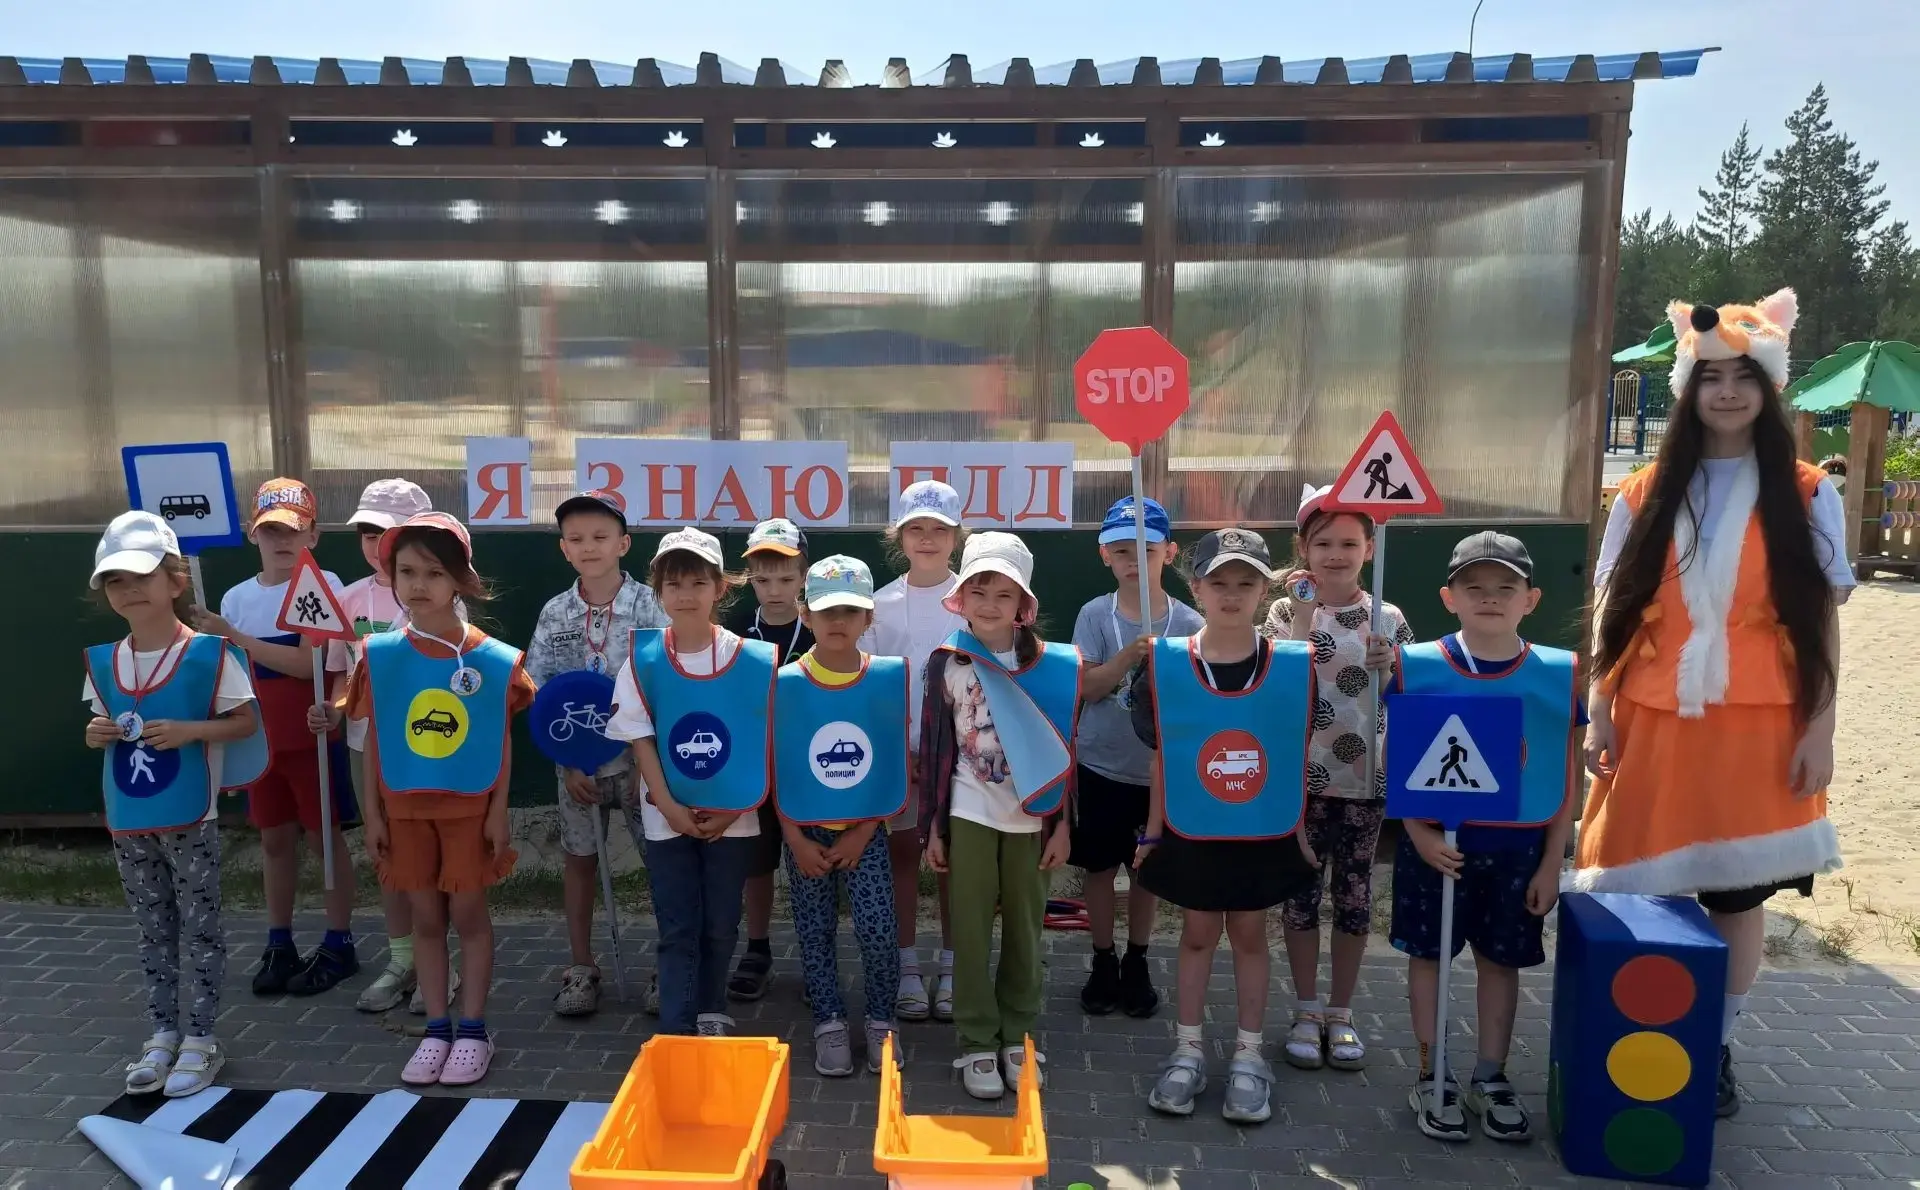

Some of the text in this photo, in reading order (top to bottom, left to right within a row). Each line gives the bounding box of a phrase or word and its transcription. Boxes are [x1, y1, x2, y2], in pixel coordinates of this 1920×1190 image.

[1086, 366, 1175, 404] STOP
[471, 462, 528, 520] Я
[588, 462, 844, 521] ЗНАЮ
[913, 490, 939, 502] SMILE
[258, 487, 304, 509] RUSSIA
[911, 500, 943, 509] MAKER
[825, 770, 856, 779] ПОЛИЦИЯ
[1225, 780, 1247, 791] МЧС
